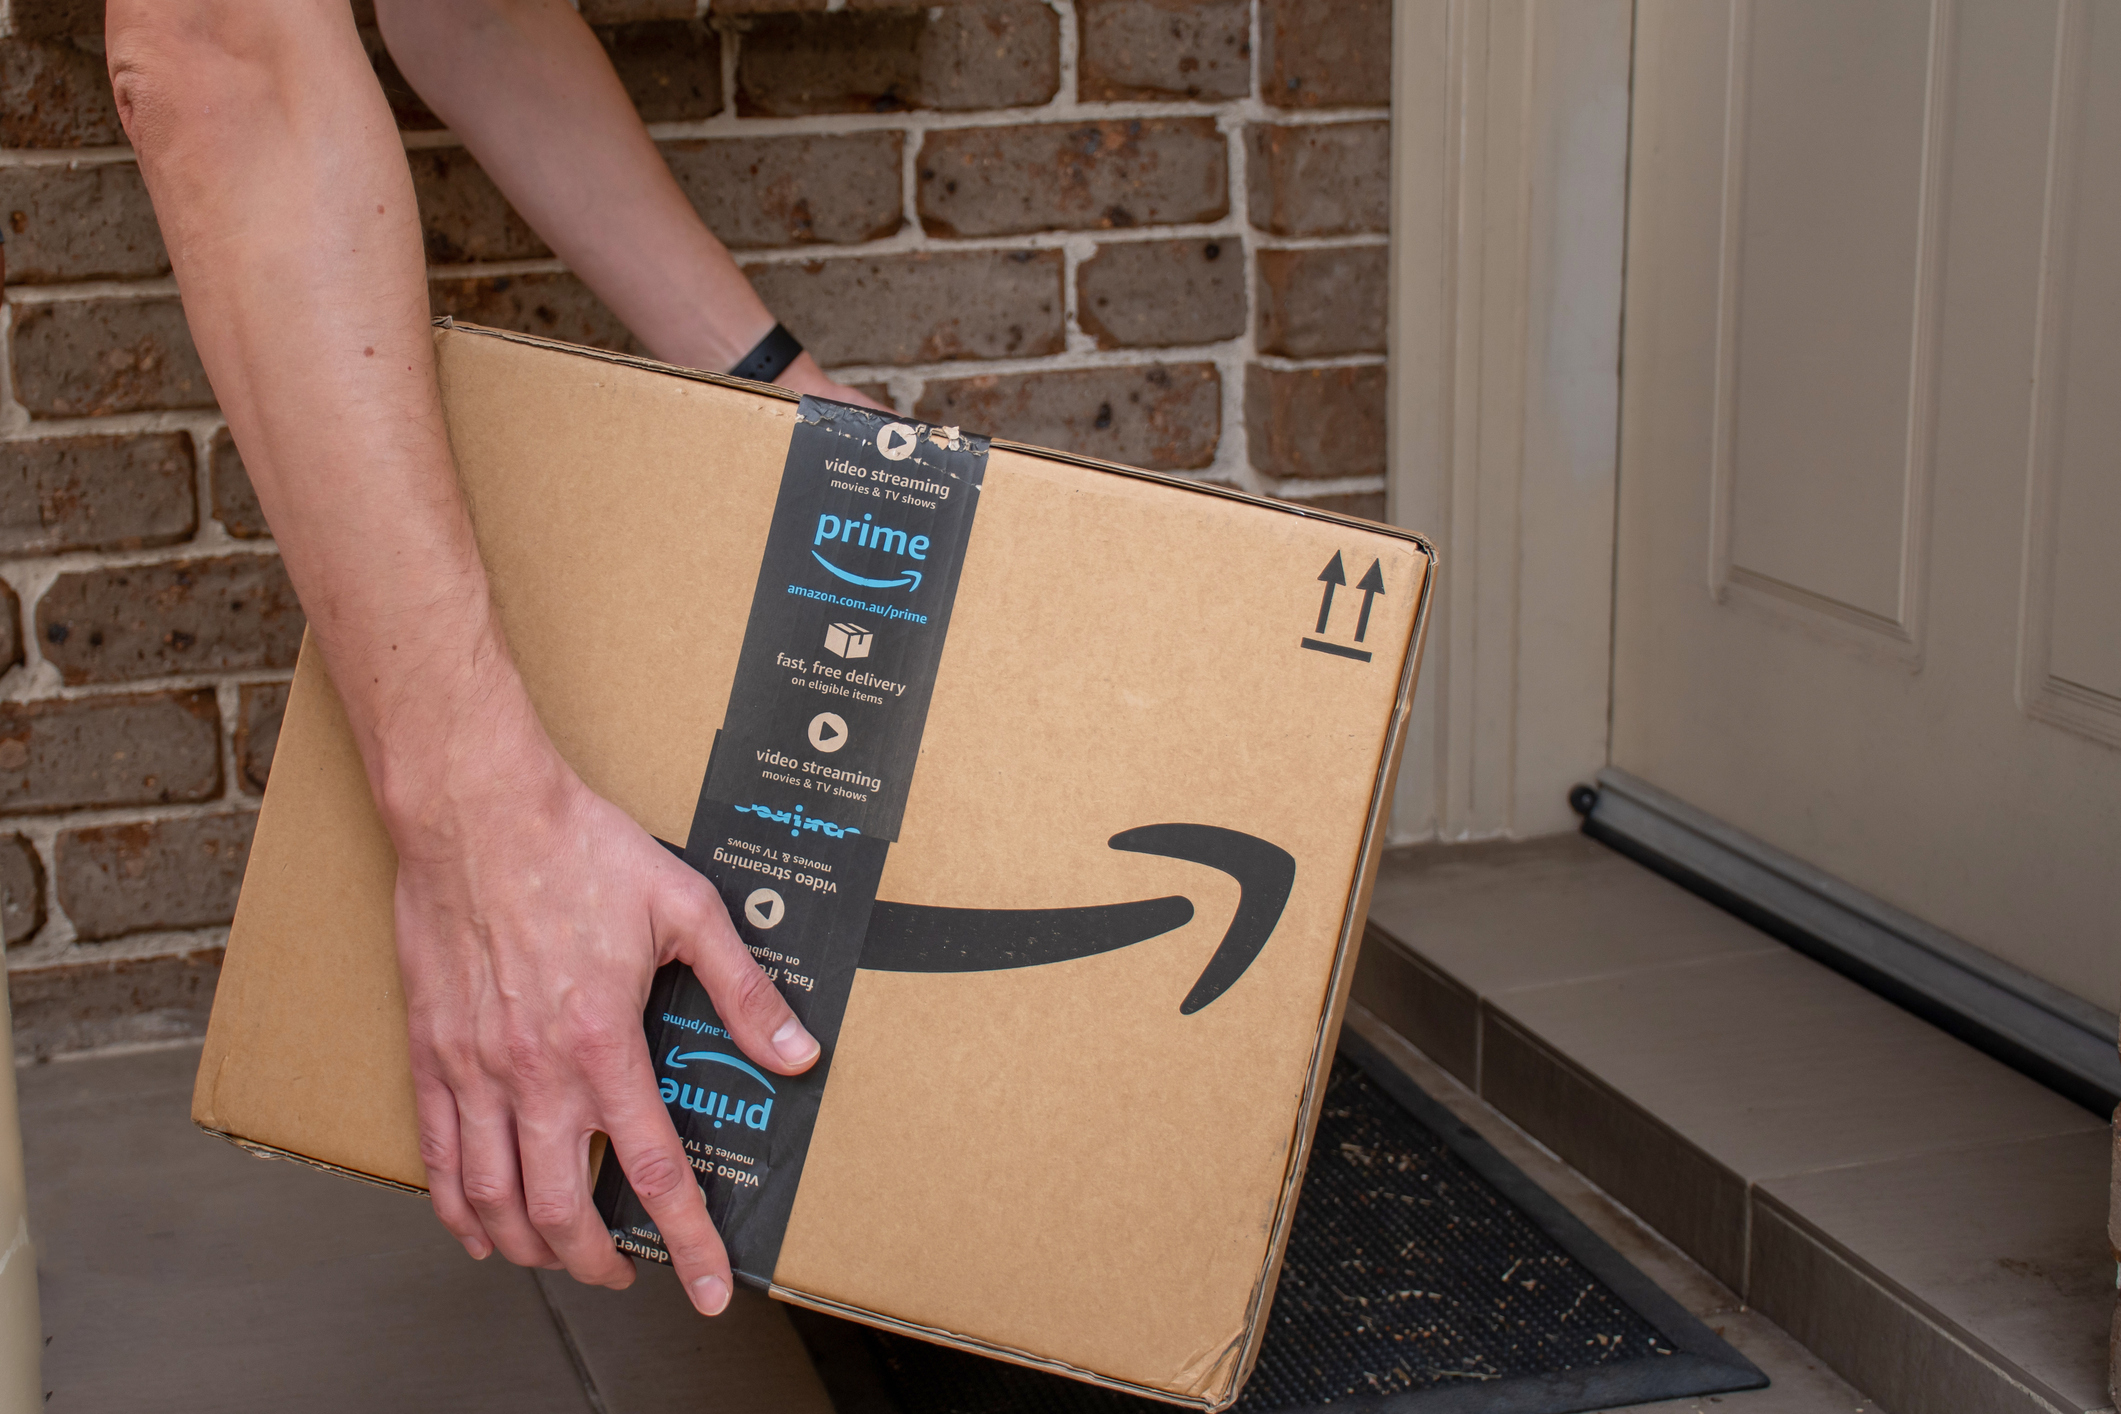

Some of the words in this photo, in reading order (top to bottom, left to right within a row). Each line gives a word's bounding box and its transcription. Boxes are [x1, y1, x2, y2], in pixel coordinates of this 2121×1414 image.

[825, 458, 867, 478] video
[870, 469, 950, 499] streaming
[830, 479, 869, 495] movies
[872, 487, 881, 498] &
[884, 490, 900, 501] TV
[902, 494, 936, 510] shows
[814, 512, 930, 560] prime
[787, 584, 928, 624] amazon.com.au/prime
[776, 652, 808, 673] fast,
[812, 660, 842, 679] free
[846, 668, 906, 696] delivery
[791, 676, 806, 687] on
[808, 678, 850, 698] eligible
[852, 688, 884, 706] items
[756, 749, 798, 770] video
[802, 760, 882, 792] streaming
[762, 769, 801, 787] movies
[803, 778, 812, 789] &
[815, 780, 832, 793] TV
[832, 785, 868, 802] shows
[727, 837, 761, 854] shows
[763, 848, 778, 860] TV
[782, 851, 791, 863] &
[713, 847, 792, 880] streaming
[793, 854, 832, 872] movies
[795, 872, 837, 894] video
[785, 955, 800, 966] on
[783, 968, 814, 992] fast,
[659, 1077, 774, 1131] prime
[685, 1139, 700, 1152] TV
[704, 1144, 714, 1155] &
[716, 1146, 754, 1166] movies
[717, 1165, 760, 1188] video
[631, 1226, 661, 1245] items
